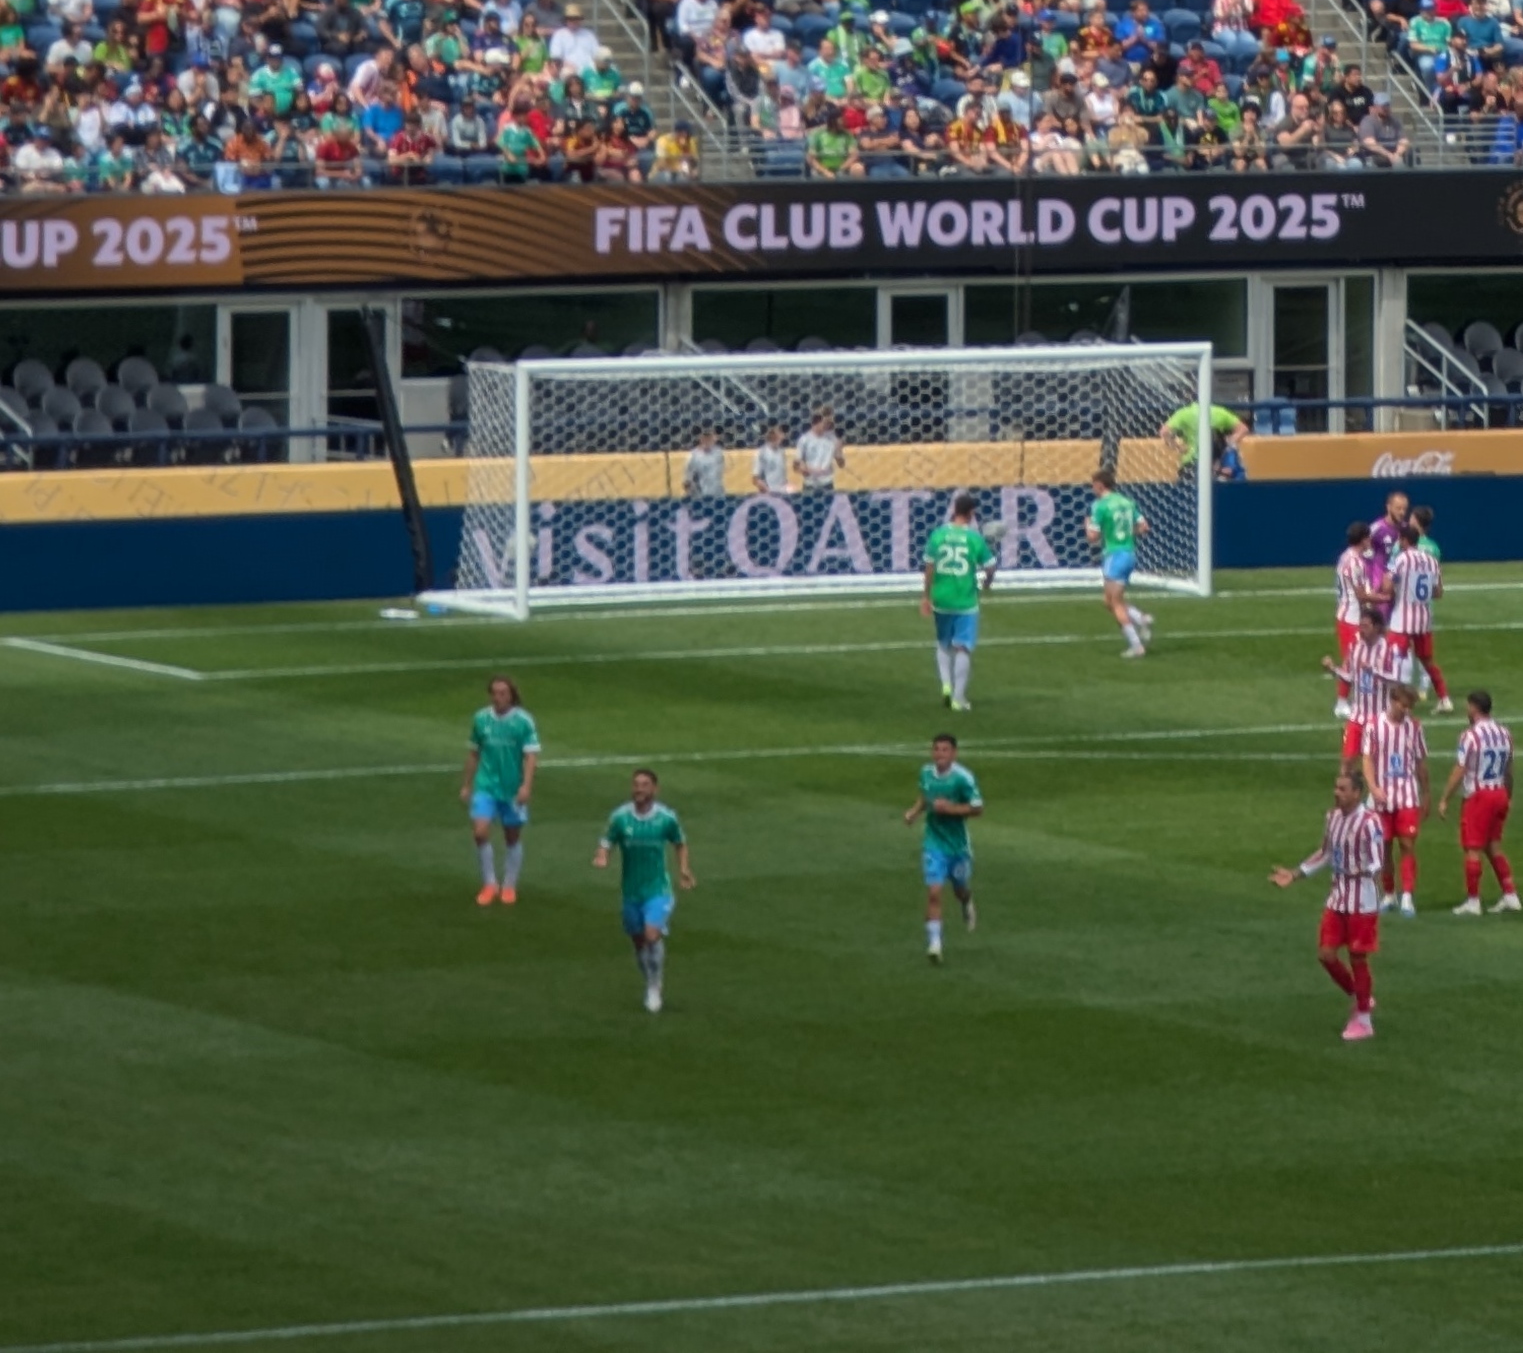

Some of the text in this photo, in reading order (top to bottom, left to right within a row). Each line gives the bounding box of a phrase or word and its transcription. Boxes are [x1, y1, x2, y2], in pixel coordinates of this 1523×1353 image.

[595, 205, 711, 252] FIFA
[723, 203, 863, 250] CLUB
[876, 199, 1076, 246] WORLD
[1088, 197, 1196, 242] CUP
[936, 546, 969, 577] 25
[1415, 575, 1429, 601] 6
